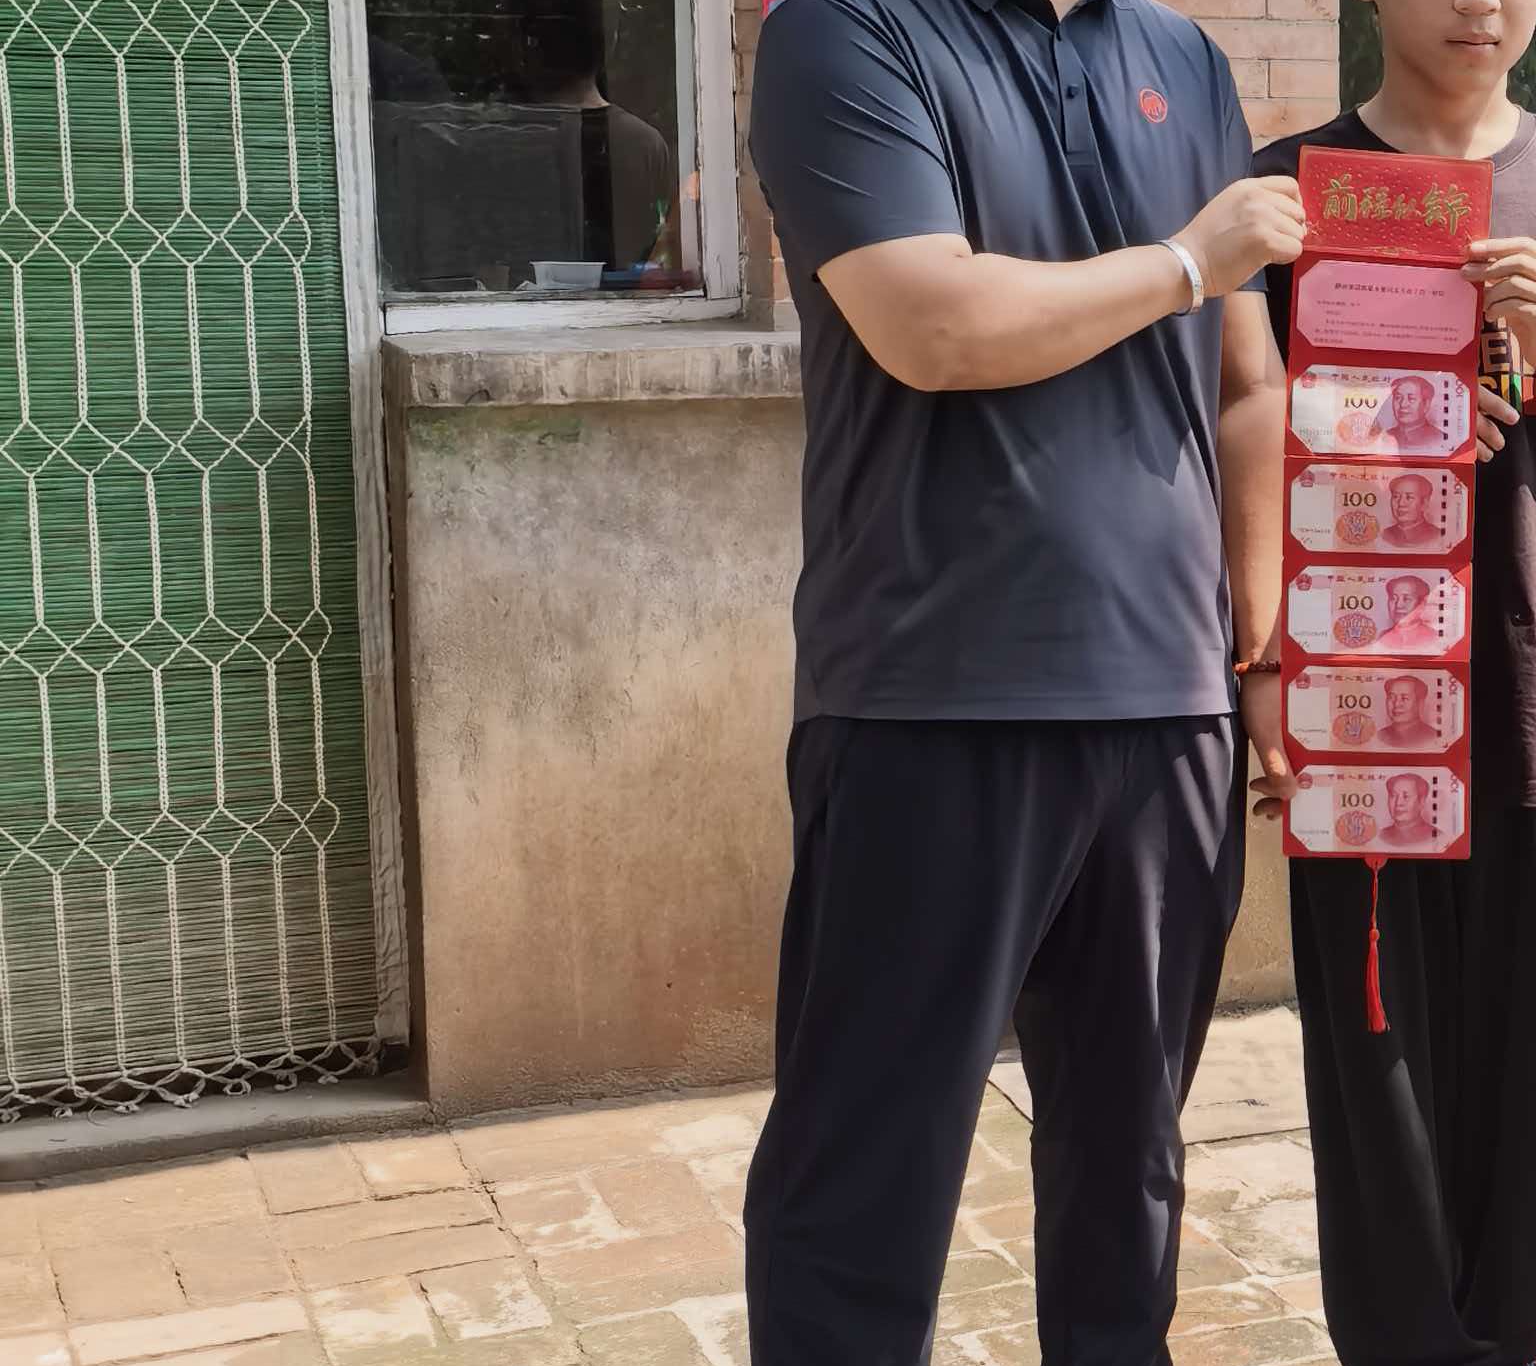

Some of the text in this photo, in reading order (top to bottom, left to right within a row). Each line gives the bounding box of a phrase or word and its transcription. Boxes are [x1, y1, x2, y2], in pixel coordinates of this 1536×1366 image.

[1344, 396, 1377, 408] 100
[1342, 492, 1377, 506] 100
[1338, 596, 1374, 610] 100
[1336, 695, 1371, 709] 100
[1341, 794, 1375, 808] 100
